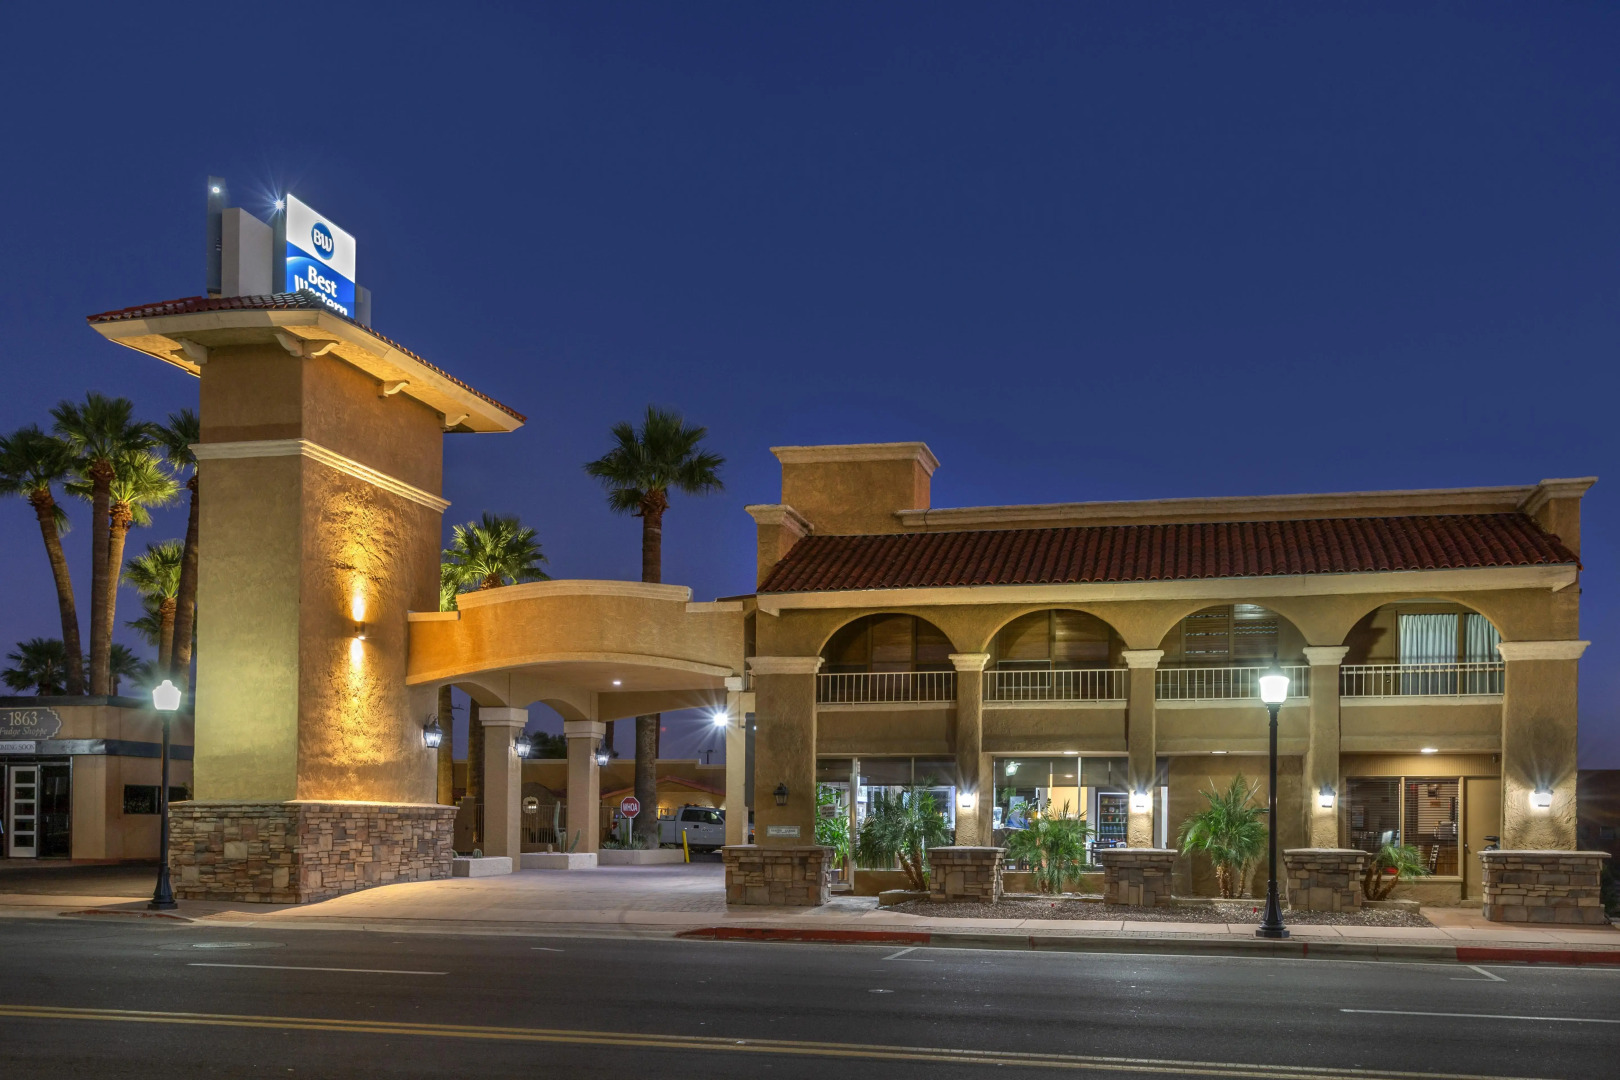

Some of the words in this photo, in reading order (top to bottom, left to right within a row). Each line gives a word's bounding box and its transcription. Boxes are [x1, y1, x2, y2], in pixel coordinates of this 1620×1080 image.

[313, 229, 332, 252] BW
[308, 265, 337, 298] Best
[294, 274, 347, 316] Wtern
[9, 711, 38, 726] 1863
[22, 726, 47, 737] Shoppe
[18, 743, 35, 751] SOON
[623, 803, 638, 811] WHOA
